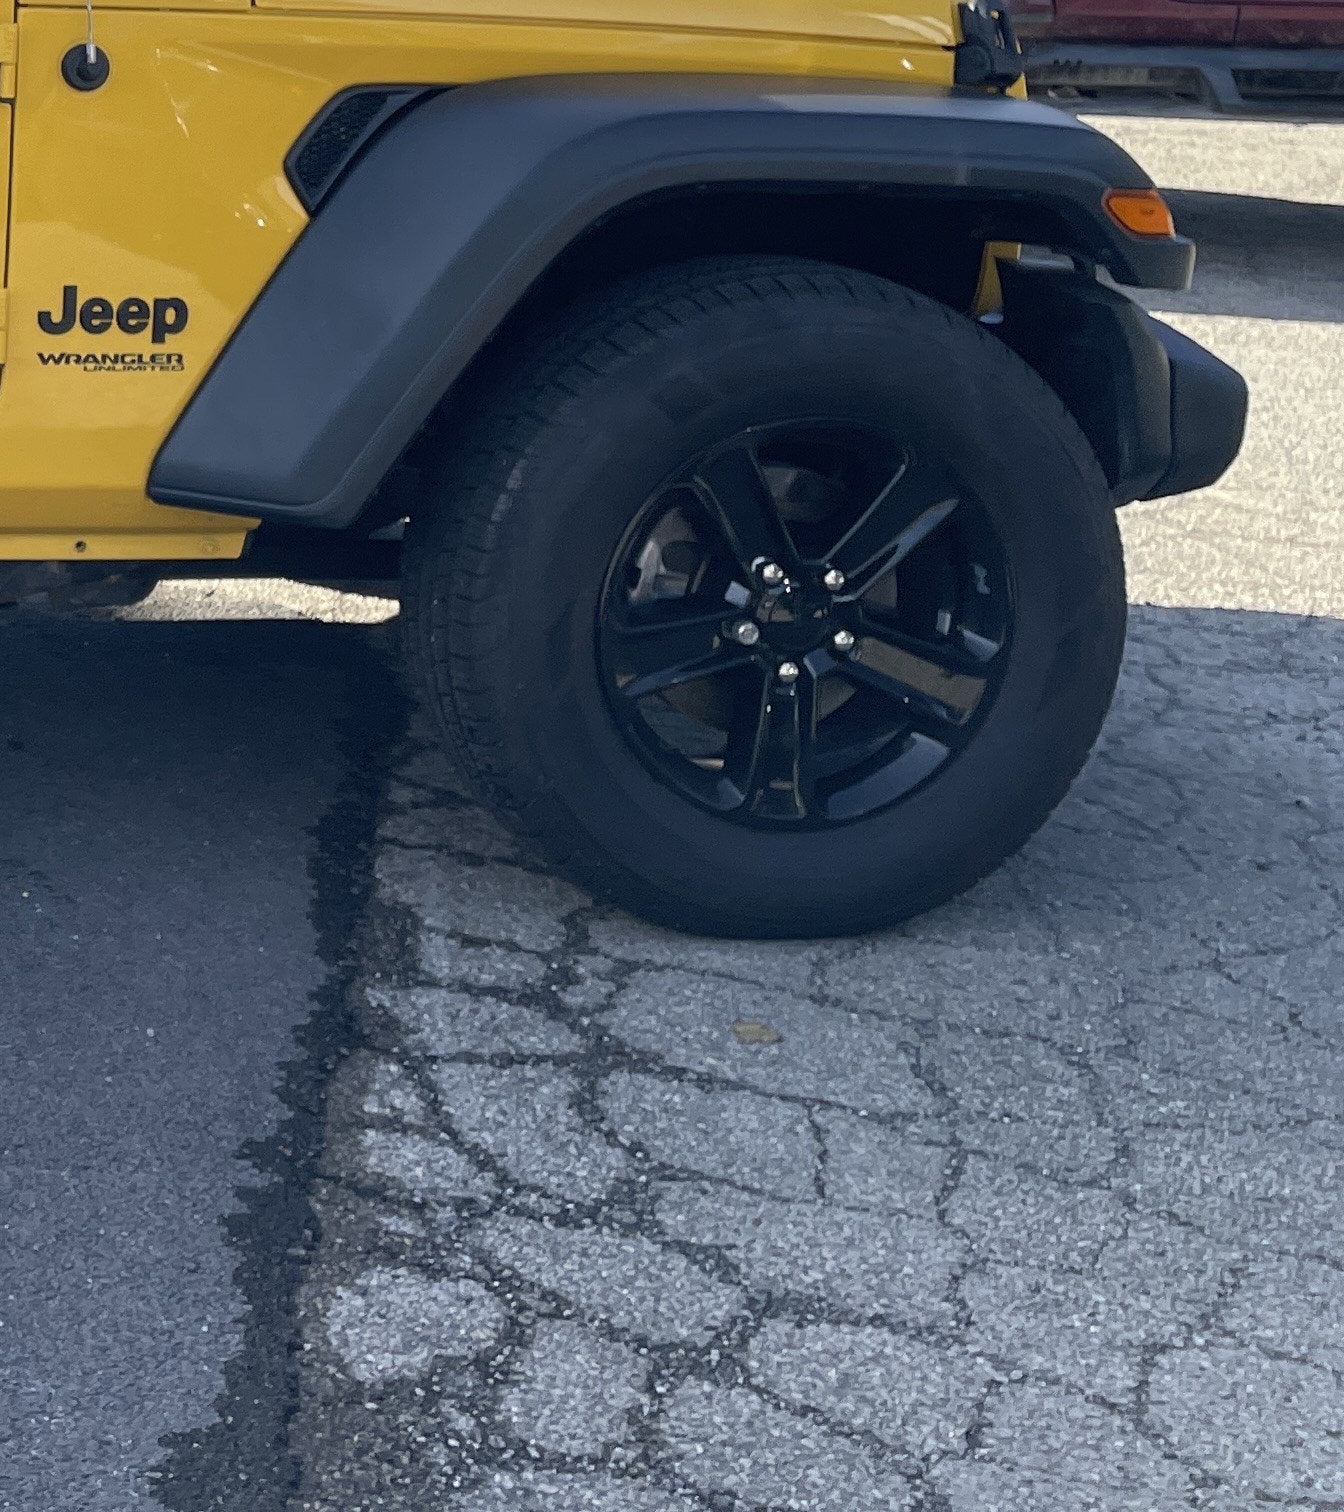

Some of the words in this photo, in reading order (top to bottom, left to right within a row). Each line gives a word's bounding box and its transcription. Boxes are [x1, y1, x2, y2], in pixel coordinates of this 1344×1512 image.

[37, 285, 188, 344] Jeep
[37, 352, 184, 365] WRANGLER
[83, 364, 185, 372] UNLIMITED
